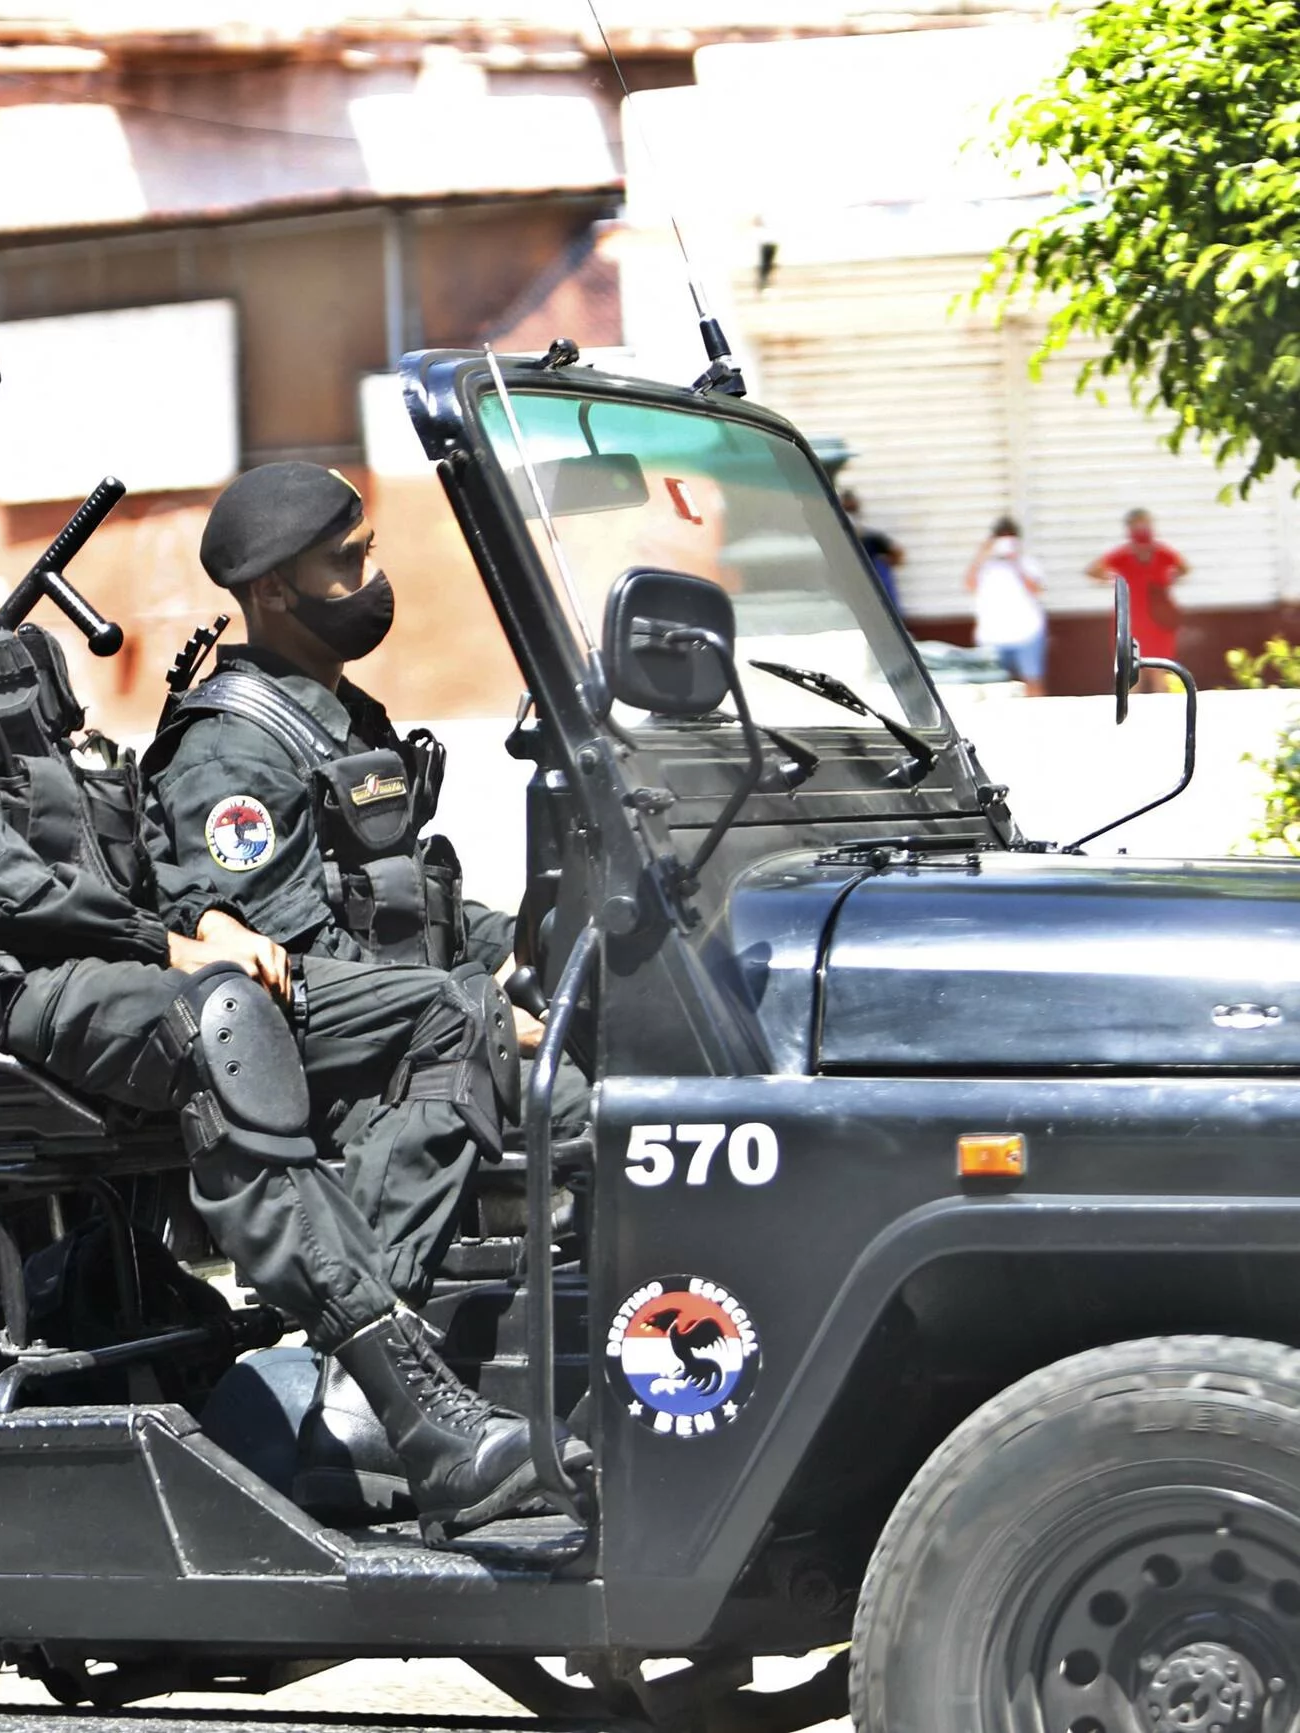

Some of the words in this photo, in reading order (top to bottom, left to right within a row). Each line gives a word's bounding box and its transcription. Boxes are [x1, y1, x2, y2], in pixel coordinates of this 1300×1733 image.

[625, 1122, 779, 1187] 570
[605, 1281, 664, 1357] DESTINO
[688, 1277, 759, 1358] ESPECIAL
[653, 1410, 716, 1436] BEN
